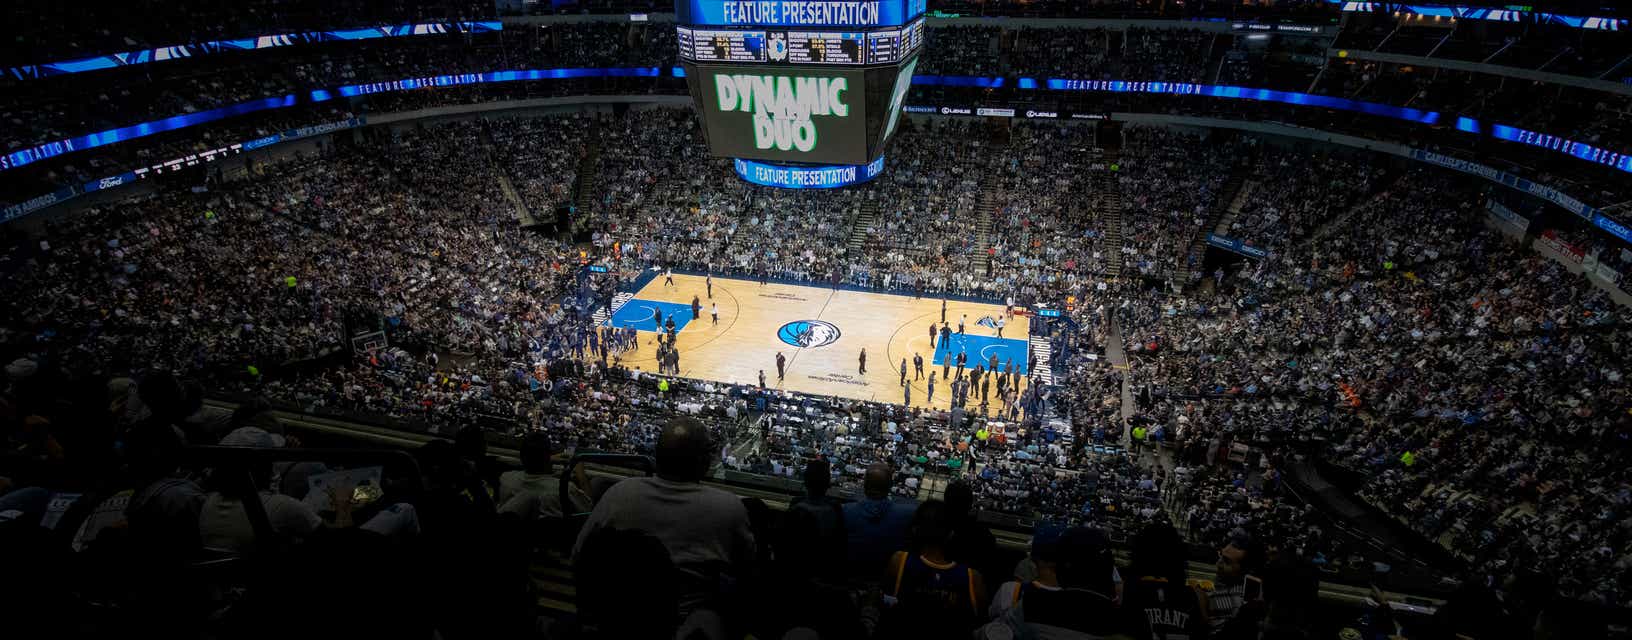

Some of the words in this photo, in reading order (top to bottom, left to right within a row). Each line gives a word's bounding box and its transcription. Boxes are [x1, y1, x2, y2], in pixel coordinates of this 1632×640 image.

[723, 2, 778, 24] FEATURE
[782, 2, 879, 26] PRESENTATION
[359, 78, 405, 95] FEATURE
[408, 72, 484, 91] PRESENTATION
[1066, 79, 1113, 92] FEATURE
[1117, 81, 1202, 96] PRESENTATION
[715, 74, 848, 117] DYNAMIC
[752, 113, 818, 153] DUO
[1518, 129, 1577, 155] FEATURE
[99, 177, 123, 190] Ford
[755, 165, 790, 184] FEATURE
[791, 166, 857, 186] PRESENTATION
